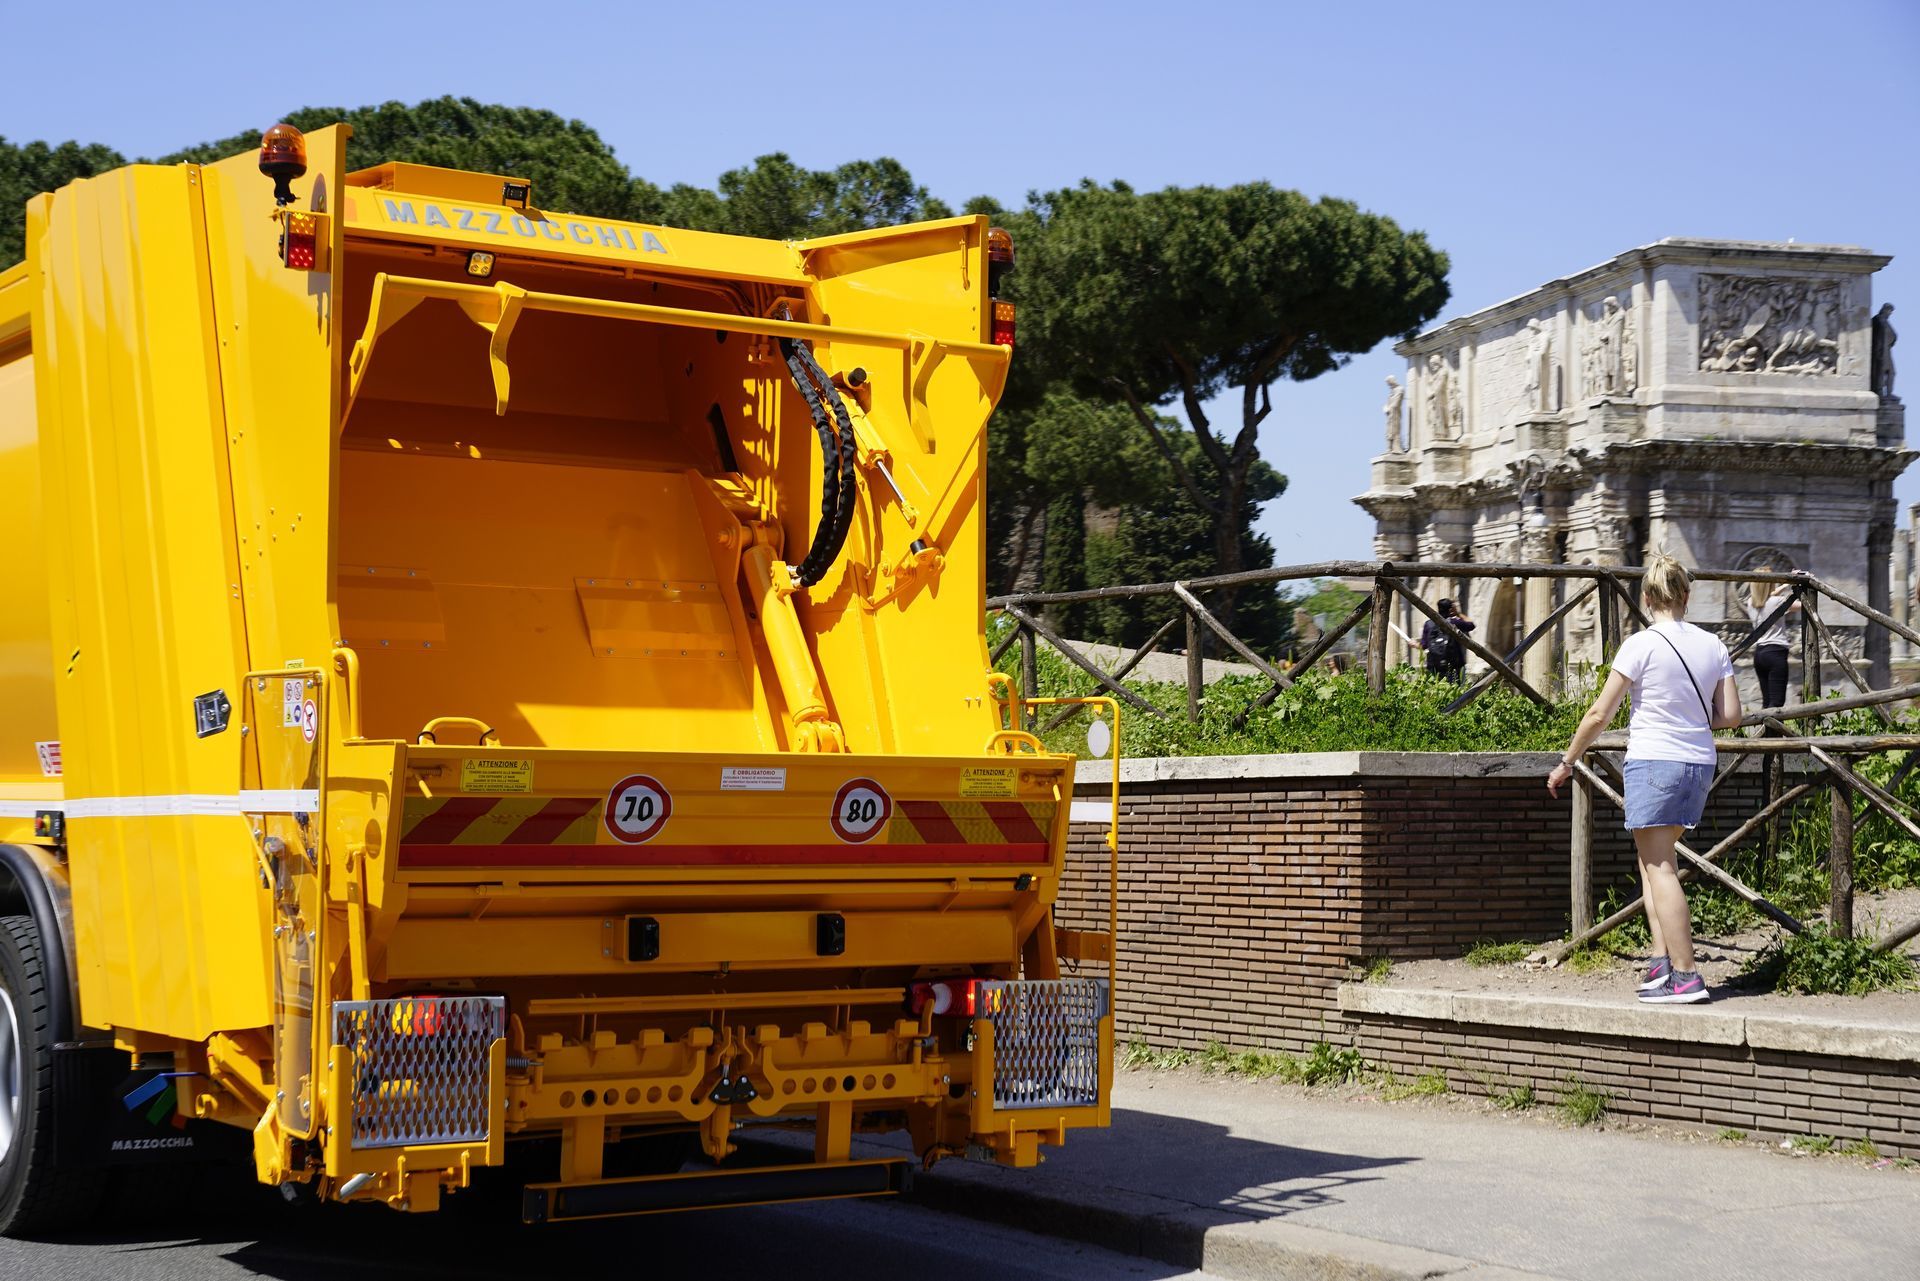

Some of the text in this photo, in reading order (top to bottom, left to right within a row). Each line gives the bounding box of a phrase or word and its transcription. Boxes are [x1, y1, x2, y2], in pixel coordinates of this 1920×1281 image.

[384, 199, 668, 254] MAZZOCCHIA
[478, 760, 518, 768] ATTENZIONE
[622, 796, 654, 822] 70
[847, 798, 876, 822] 80
[111, 1137, 194, 1150] MAZZOCCHIA
